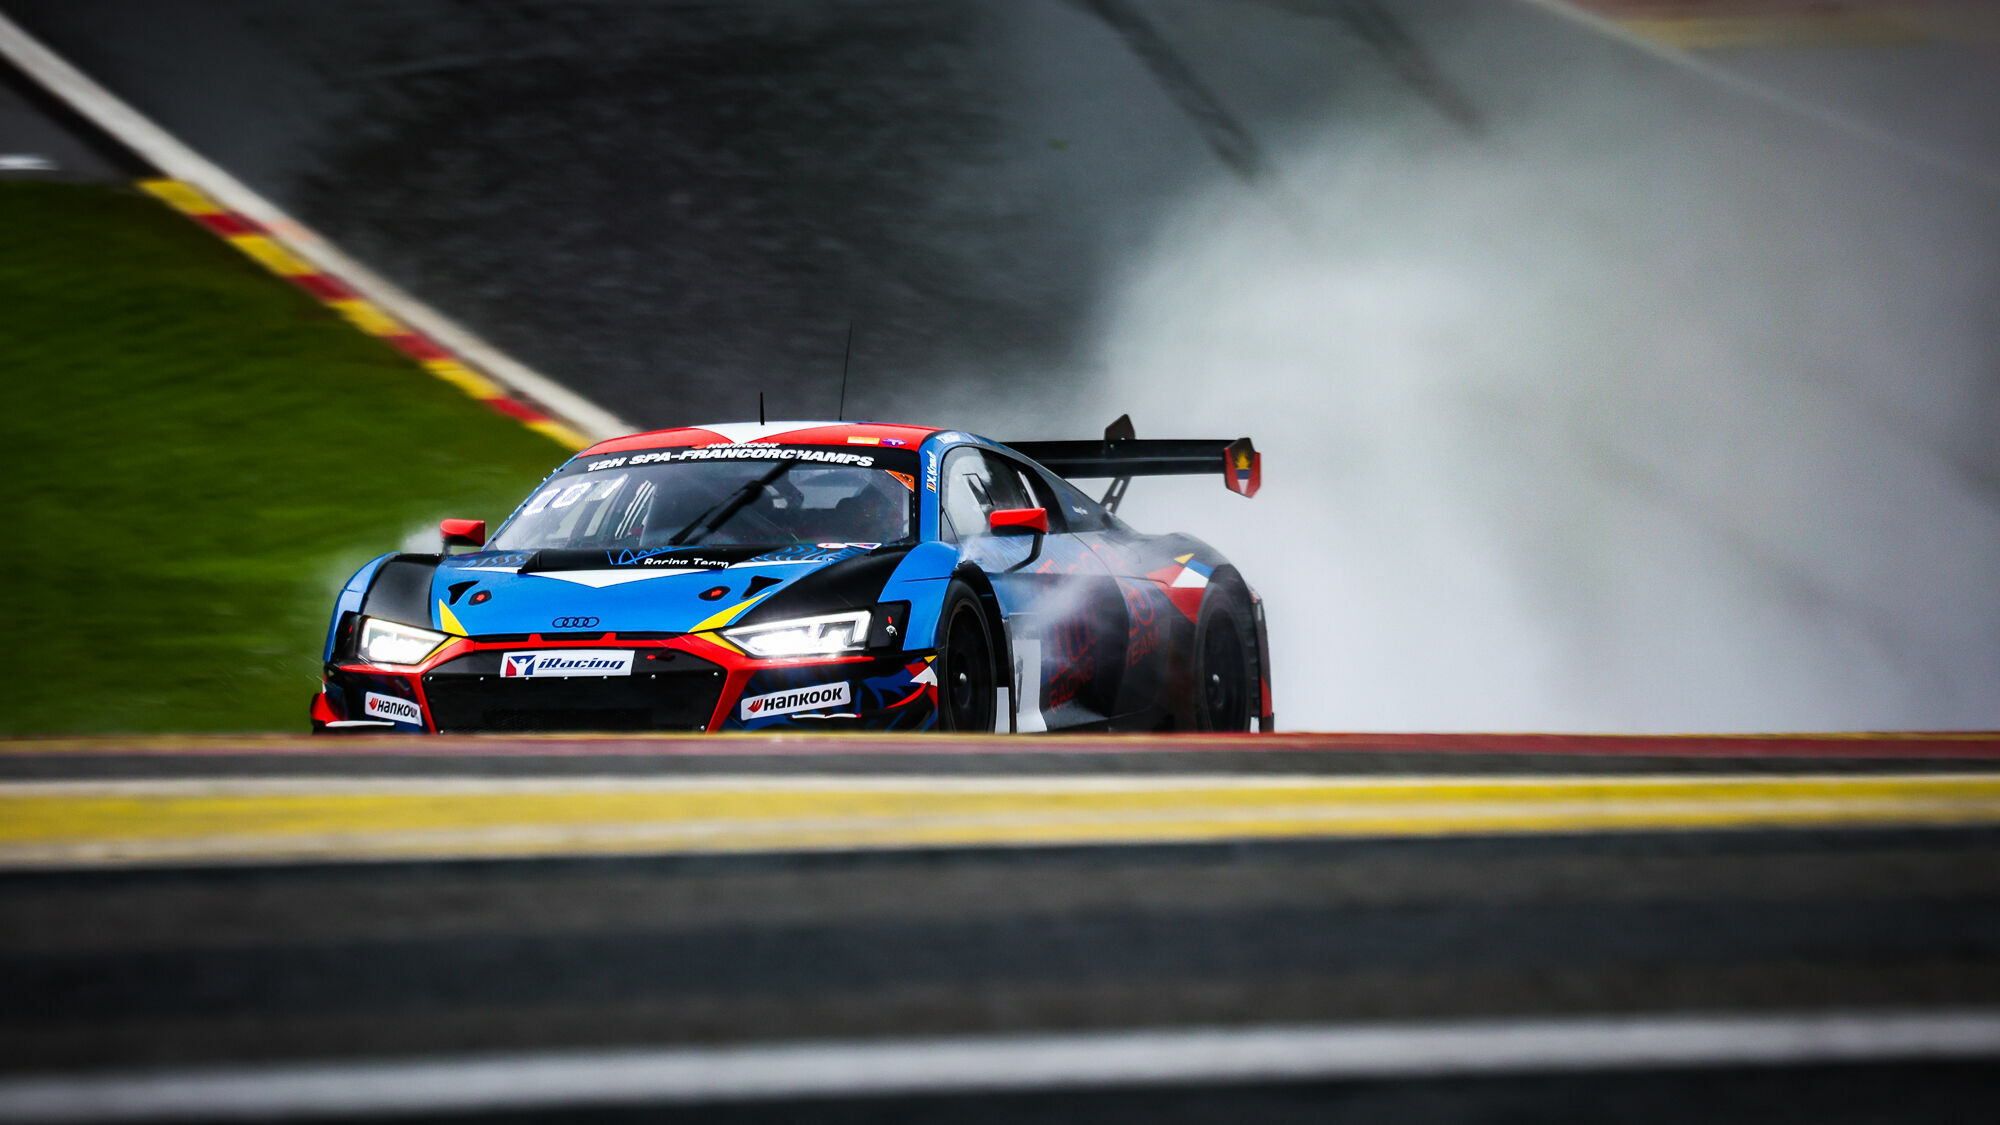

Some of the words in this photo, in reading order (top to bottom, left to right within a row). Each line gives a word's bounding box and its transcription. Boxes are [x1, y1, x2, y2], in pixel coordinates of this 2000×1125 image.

[588, 457, 627, 472] 12H
[629, 448, 875, 467] SPA-FRANCORCHAMPS
[537, 657, 626, 670] iRacing
[377, 699, 418, 718] HANKOO
[763, 687, 843, 712] HANKOOK
